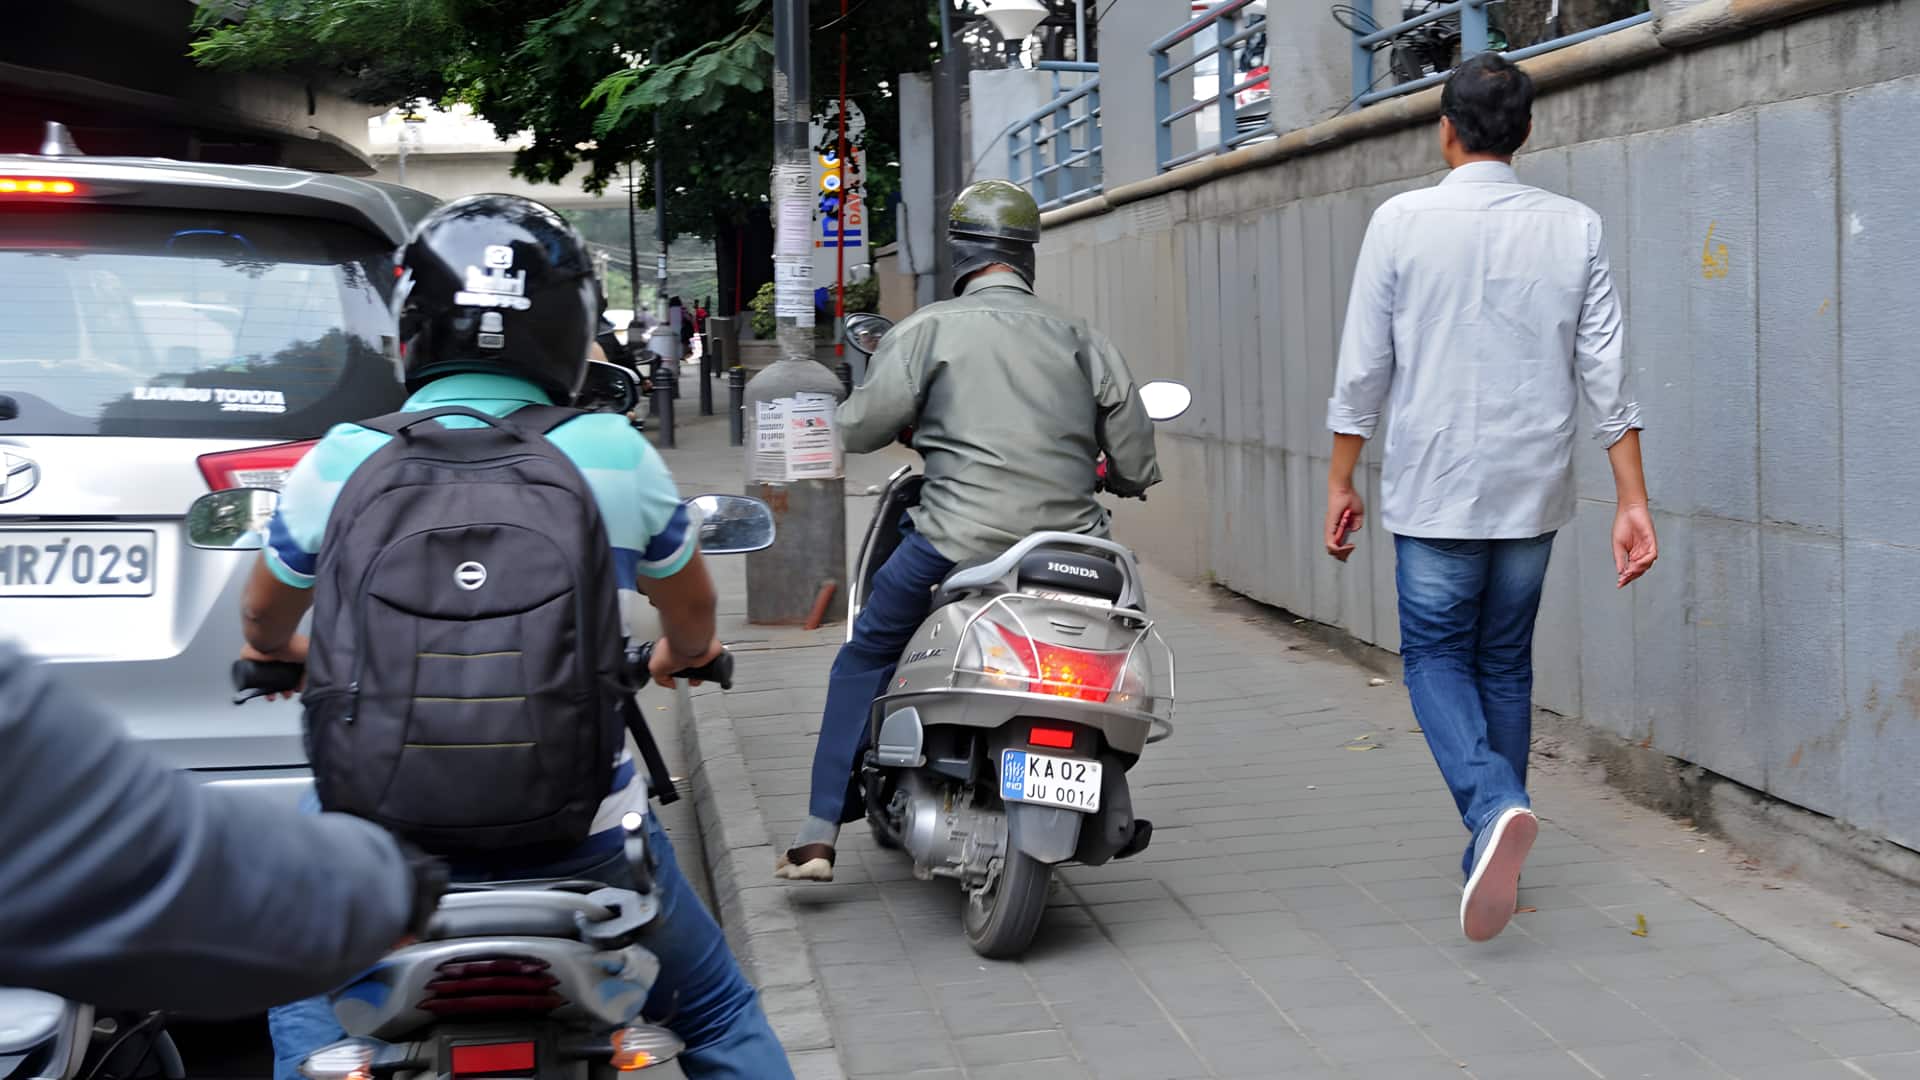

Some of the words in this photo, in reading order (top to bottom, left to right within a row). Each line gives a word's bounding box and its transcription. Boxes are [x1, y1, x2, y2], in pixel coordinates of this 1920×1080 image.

[213, 388, 286, 405] TOYOTA
[1047, 561, 1099, 579] HONDA
[1026, 783, 1047, 799] JU
